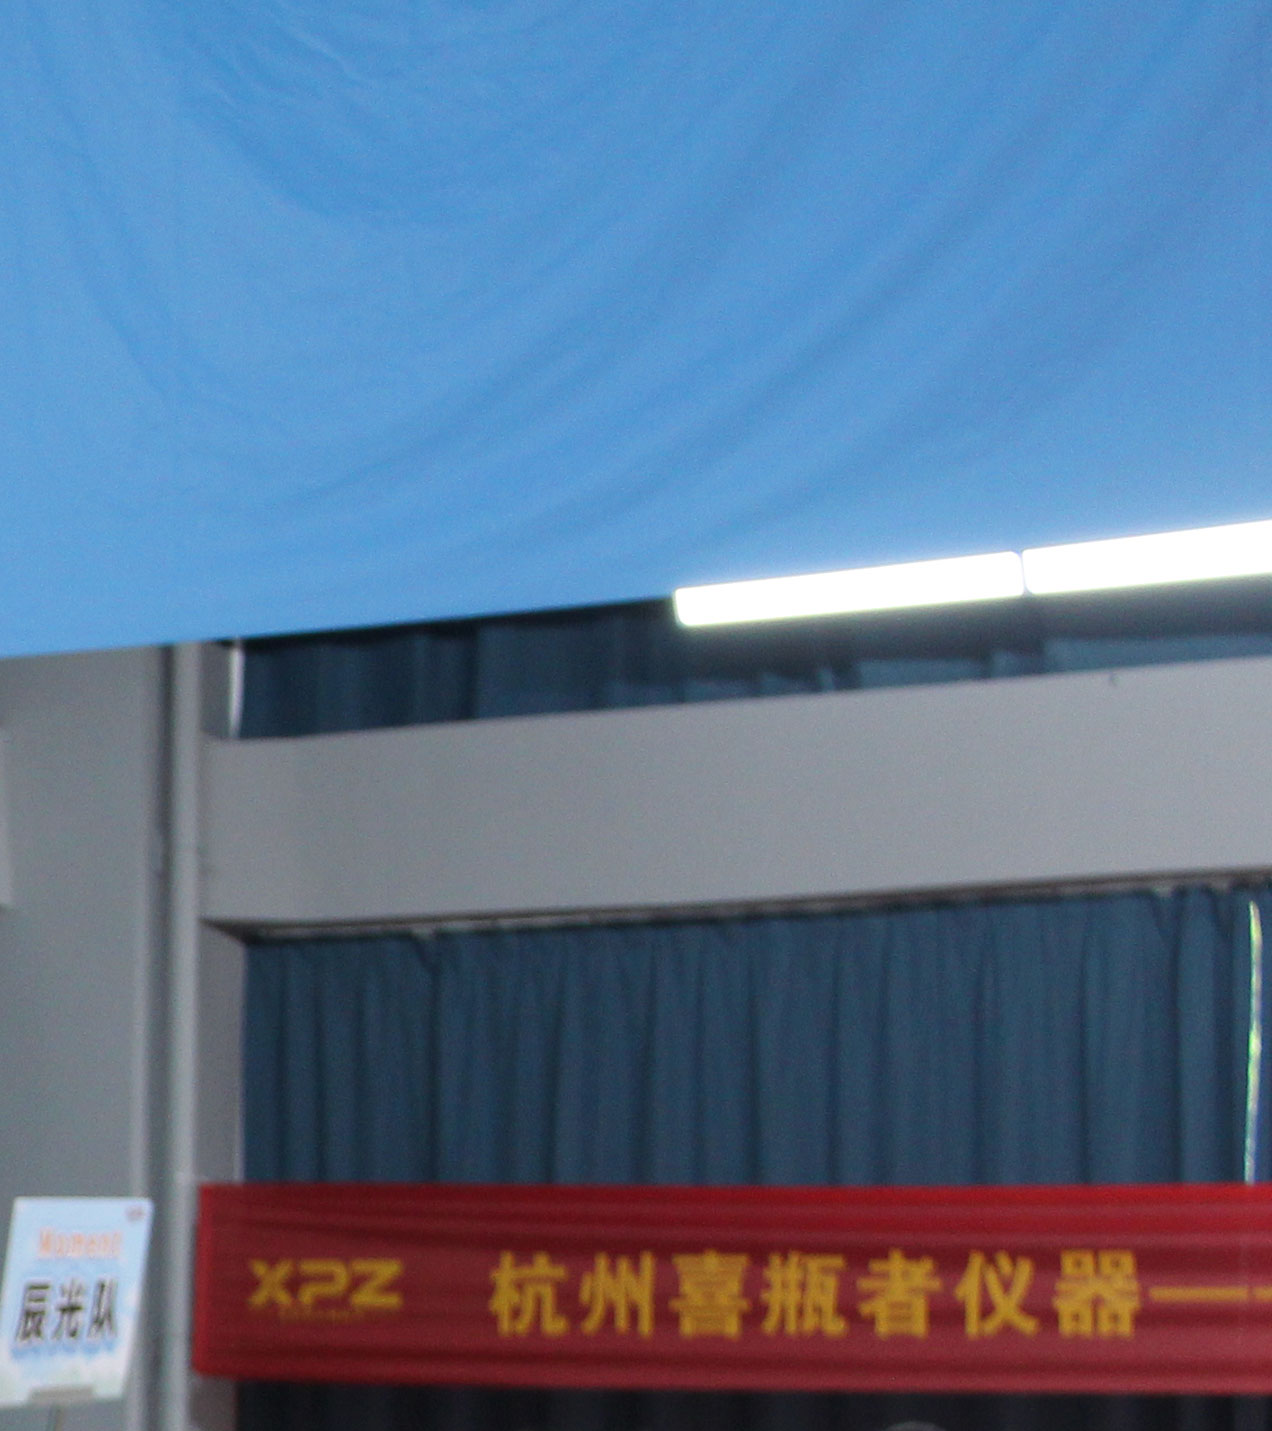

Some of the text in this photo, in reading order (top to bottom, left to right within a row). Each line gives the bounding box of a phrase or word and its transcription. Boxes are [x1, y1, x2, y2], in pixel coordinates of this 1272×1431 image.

[17, 1278, 116, 1341] 辰光队
[247, 1258, 403, 1308] XPZ
